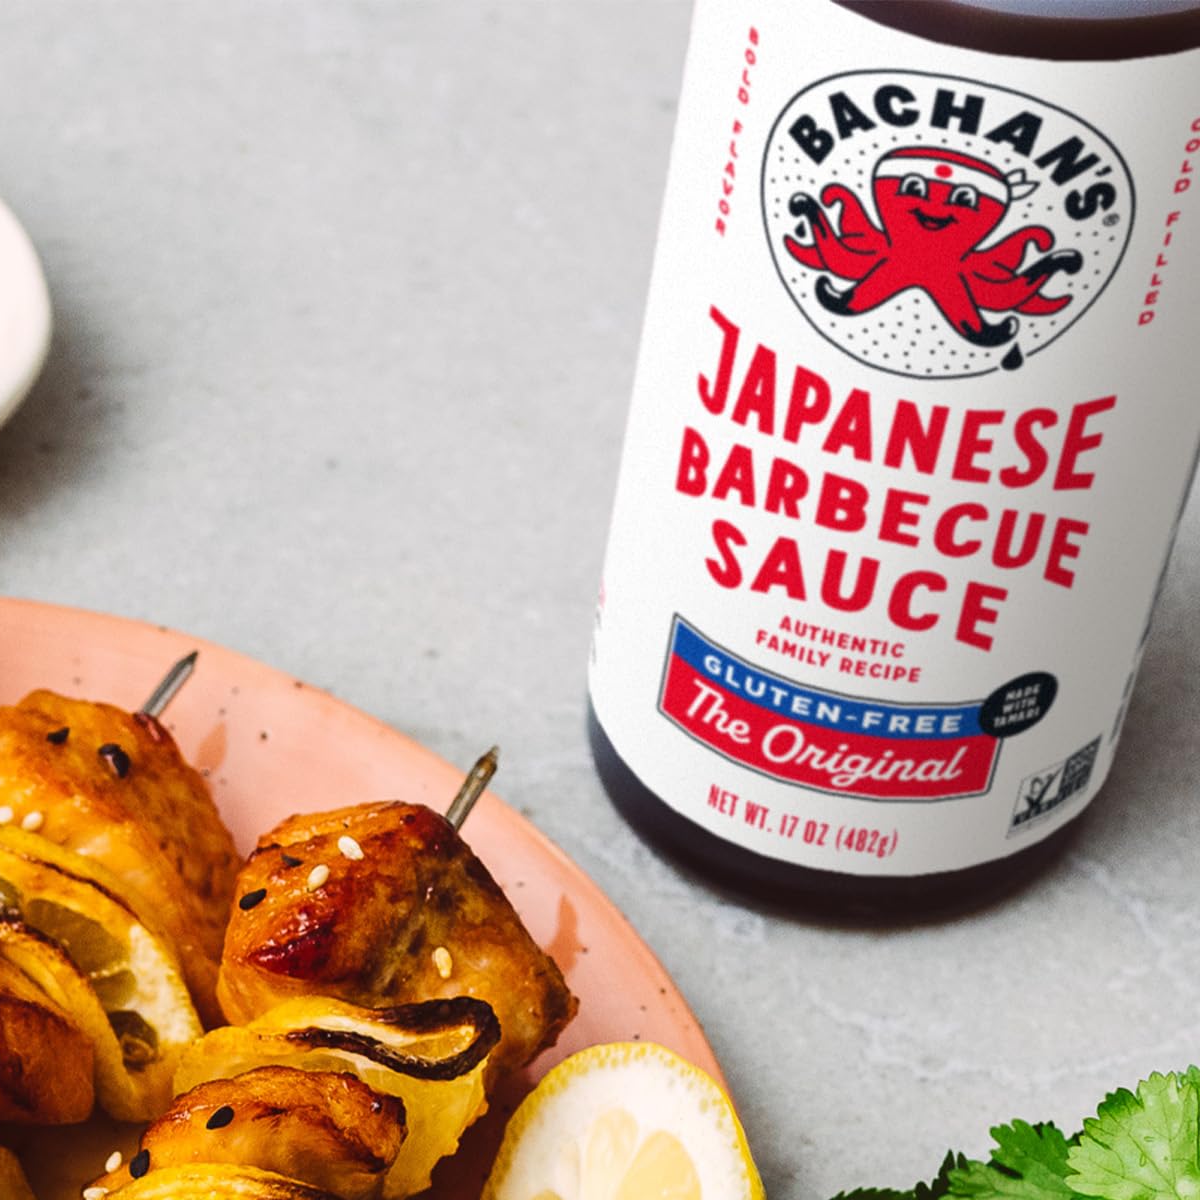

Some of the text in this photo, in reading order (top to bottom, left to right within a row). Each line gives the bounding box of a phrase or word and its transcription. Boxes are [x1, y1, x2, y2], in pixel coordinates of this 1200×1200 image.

[788, 84, 1117, 221] BACHAN'S
[1137, 211, 1181, 326] FILLED
[698, 304, 1117, 491] JAPANESE
[675, 426, 1089, 589] BARBECUE
[705, 519, 1008, 652] SAUCE
[779, 615, 906, 659] AUTHENTIC
[703, 655, 963, 734] GLUTEN-FREE
[756, 629, 922, 683] FAMILY RECIPE
[686, 679, 969, 787] The Original
[707, 784, 899, 859] NET WT. 17 OZ (482g)
